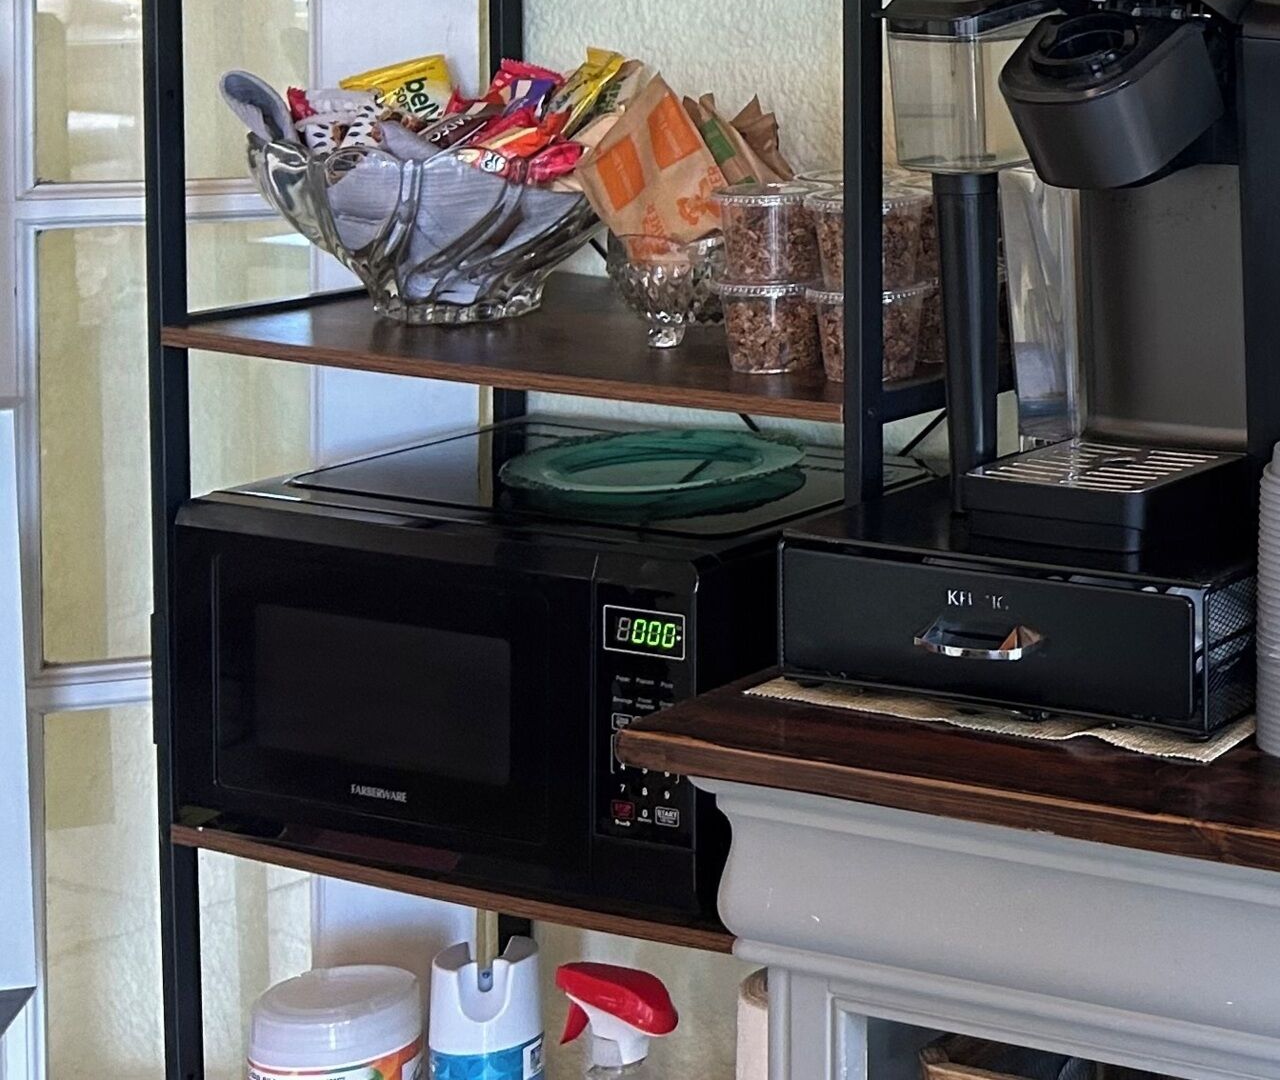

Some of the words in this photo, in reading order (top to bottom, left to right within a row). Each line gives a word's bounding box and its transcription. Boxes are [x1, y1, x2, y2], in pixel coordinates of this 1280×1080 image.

[620, 783, 626, 792] 7
[642, 787, 648, 796] 8
[664, 791, 670, 800] 9
[642, 809, 648, 817] 0
